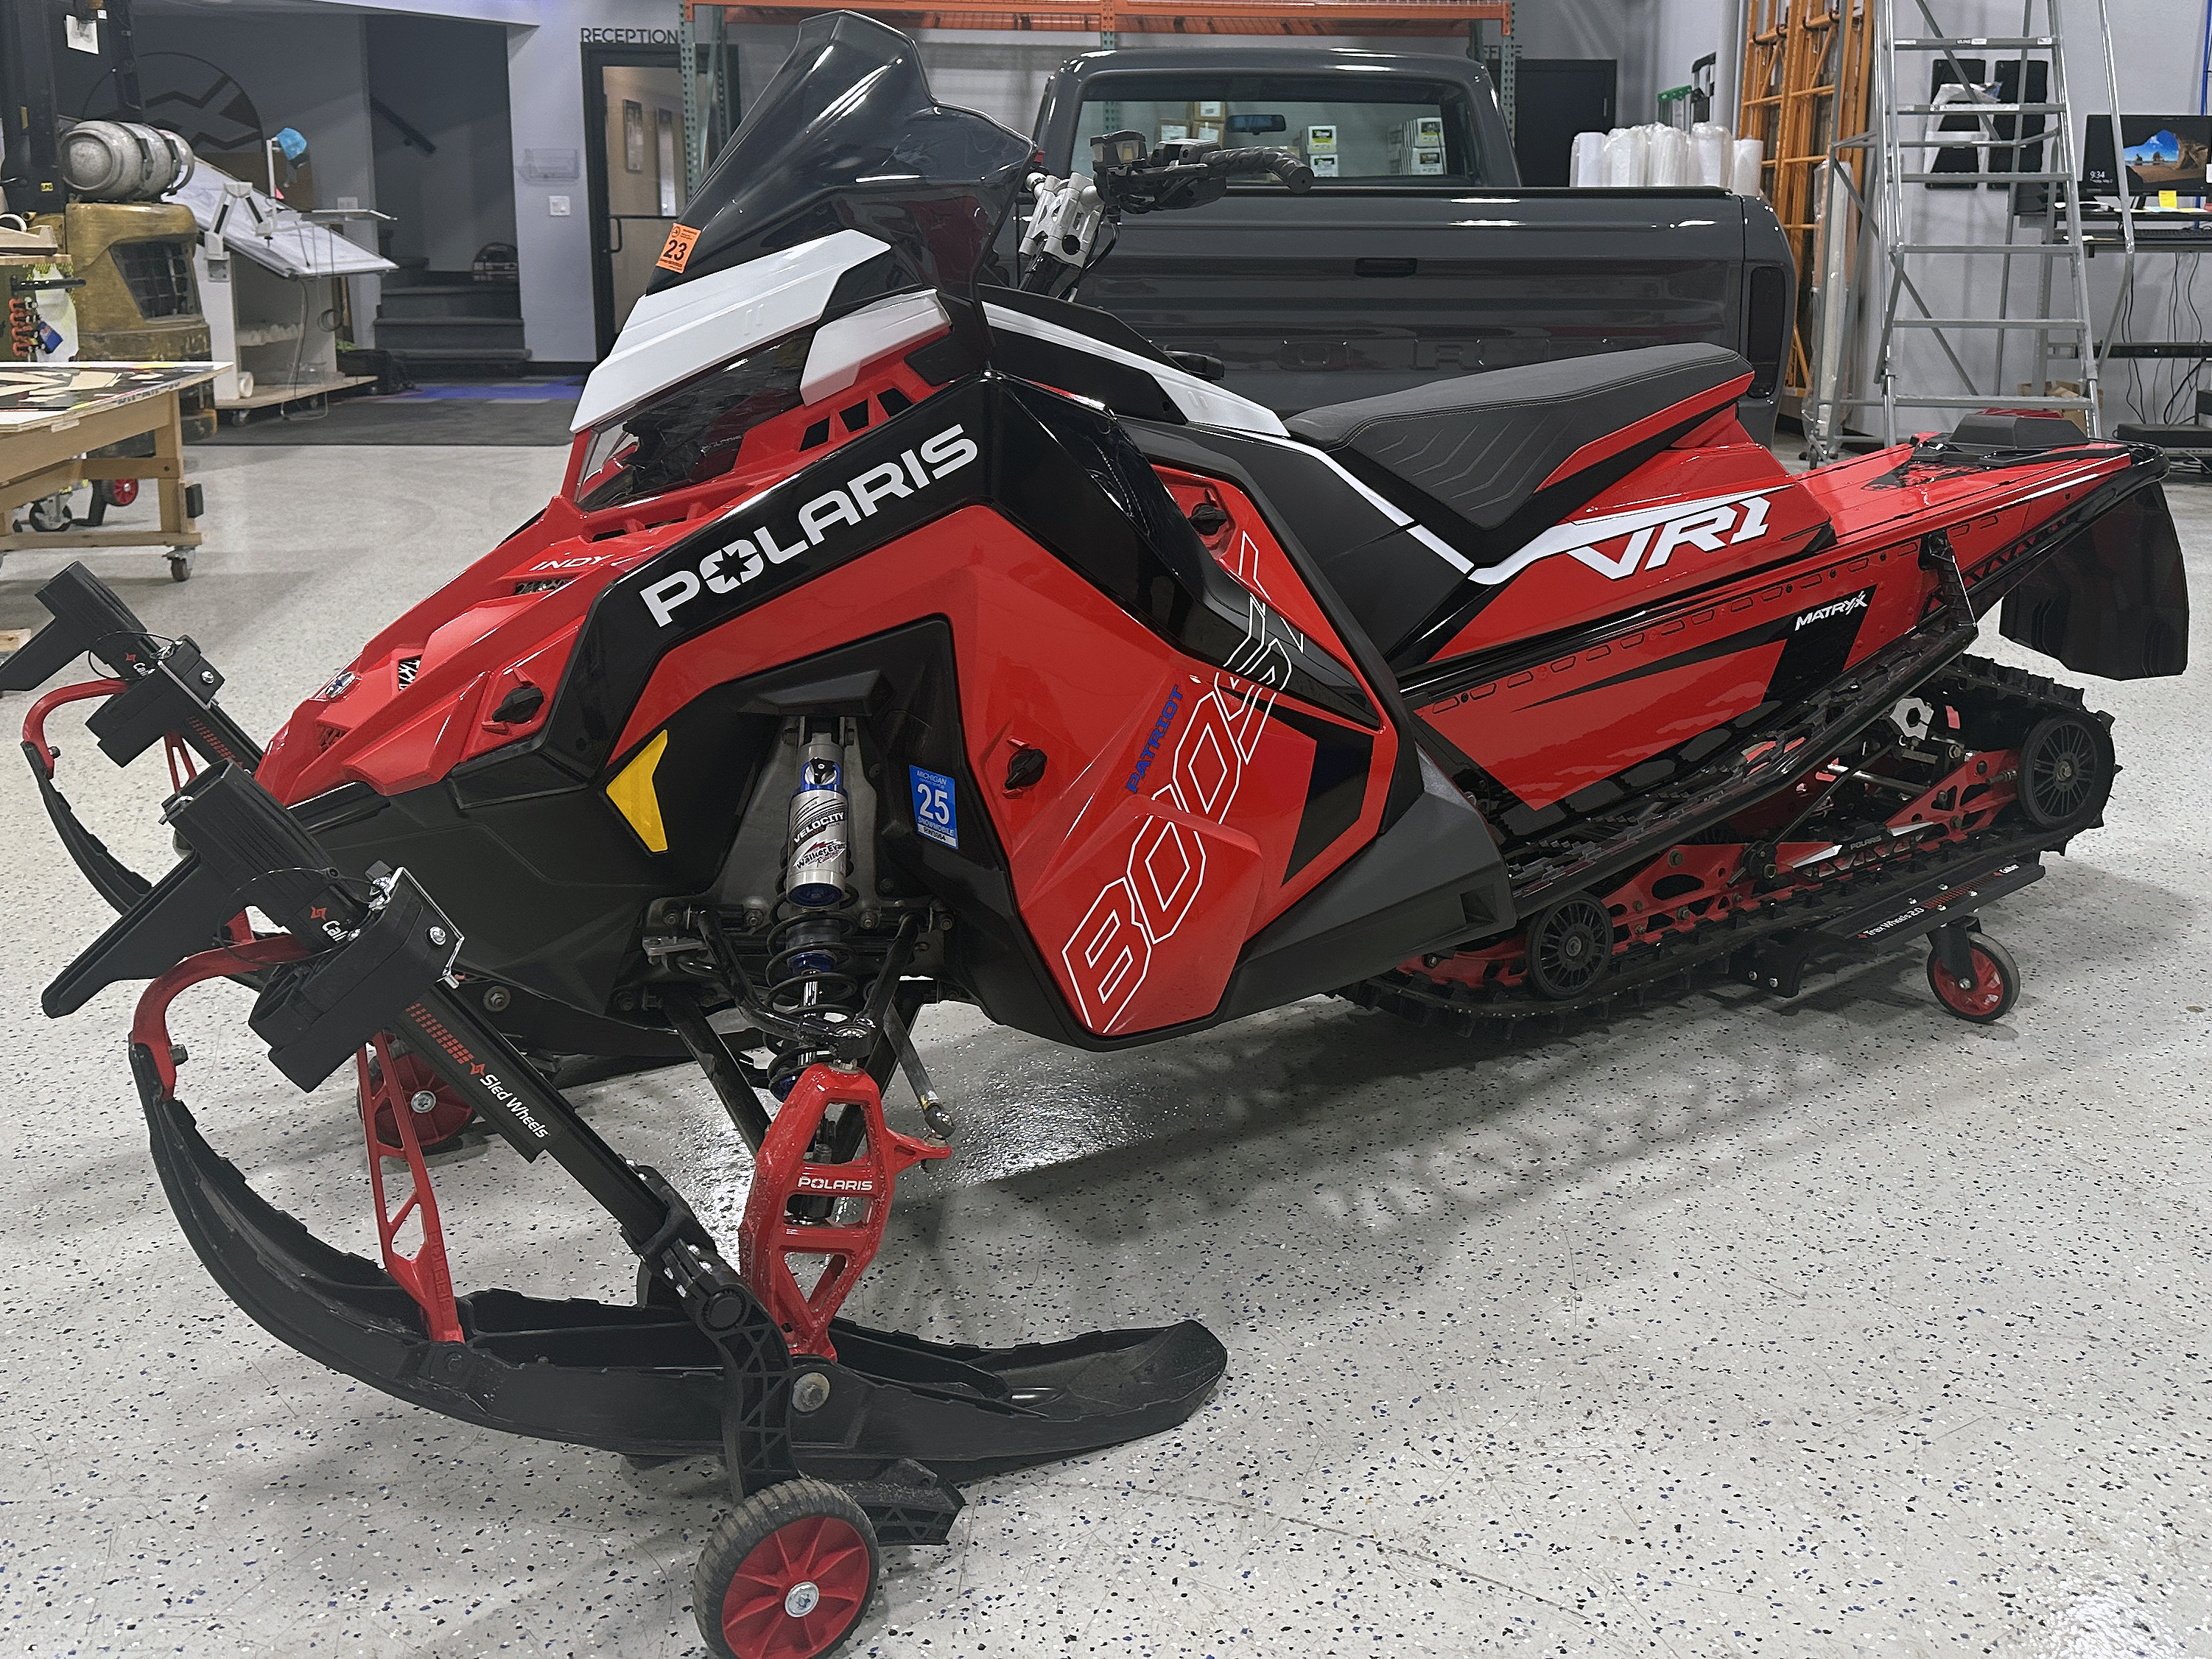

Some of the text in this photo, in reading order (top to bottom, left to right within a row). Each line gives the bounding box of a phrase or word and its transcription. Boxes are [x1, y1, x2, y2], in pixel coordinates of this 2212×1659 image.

[580, 27, 678, 44] RECEPTION
[663, 239, 687, 261] 23
[639, 424, 978, 628] POLARIS
[1566, 496, 1771, 580] VR1
[529, 554, 616, 572] INDY
[1795, 590, 1868, 631] MATRYX
[1126, 684, 1183, 793] PATRIOT
[917, 771, 947, 785] MICHIGAN
[1063, 529, 1304, 1034] BOOST
[918, 784, 949, 825] 25
[794, 812, 844, 843] VELOCITY
[918, 816, 955, 835] SNOWMOBILE
[1850, 834, 1882, 850] POLARIS
[480, 1074, 549, 1138] Sled Wheels
[798, 1177, 873, 1190] POLARIS
